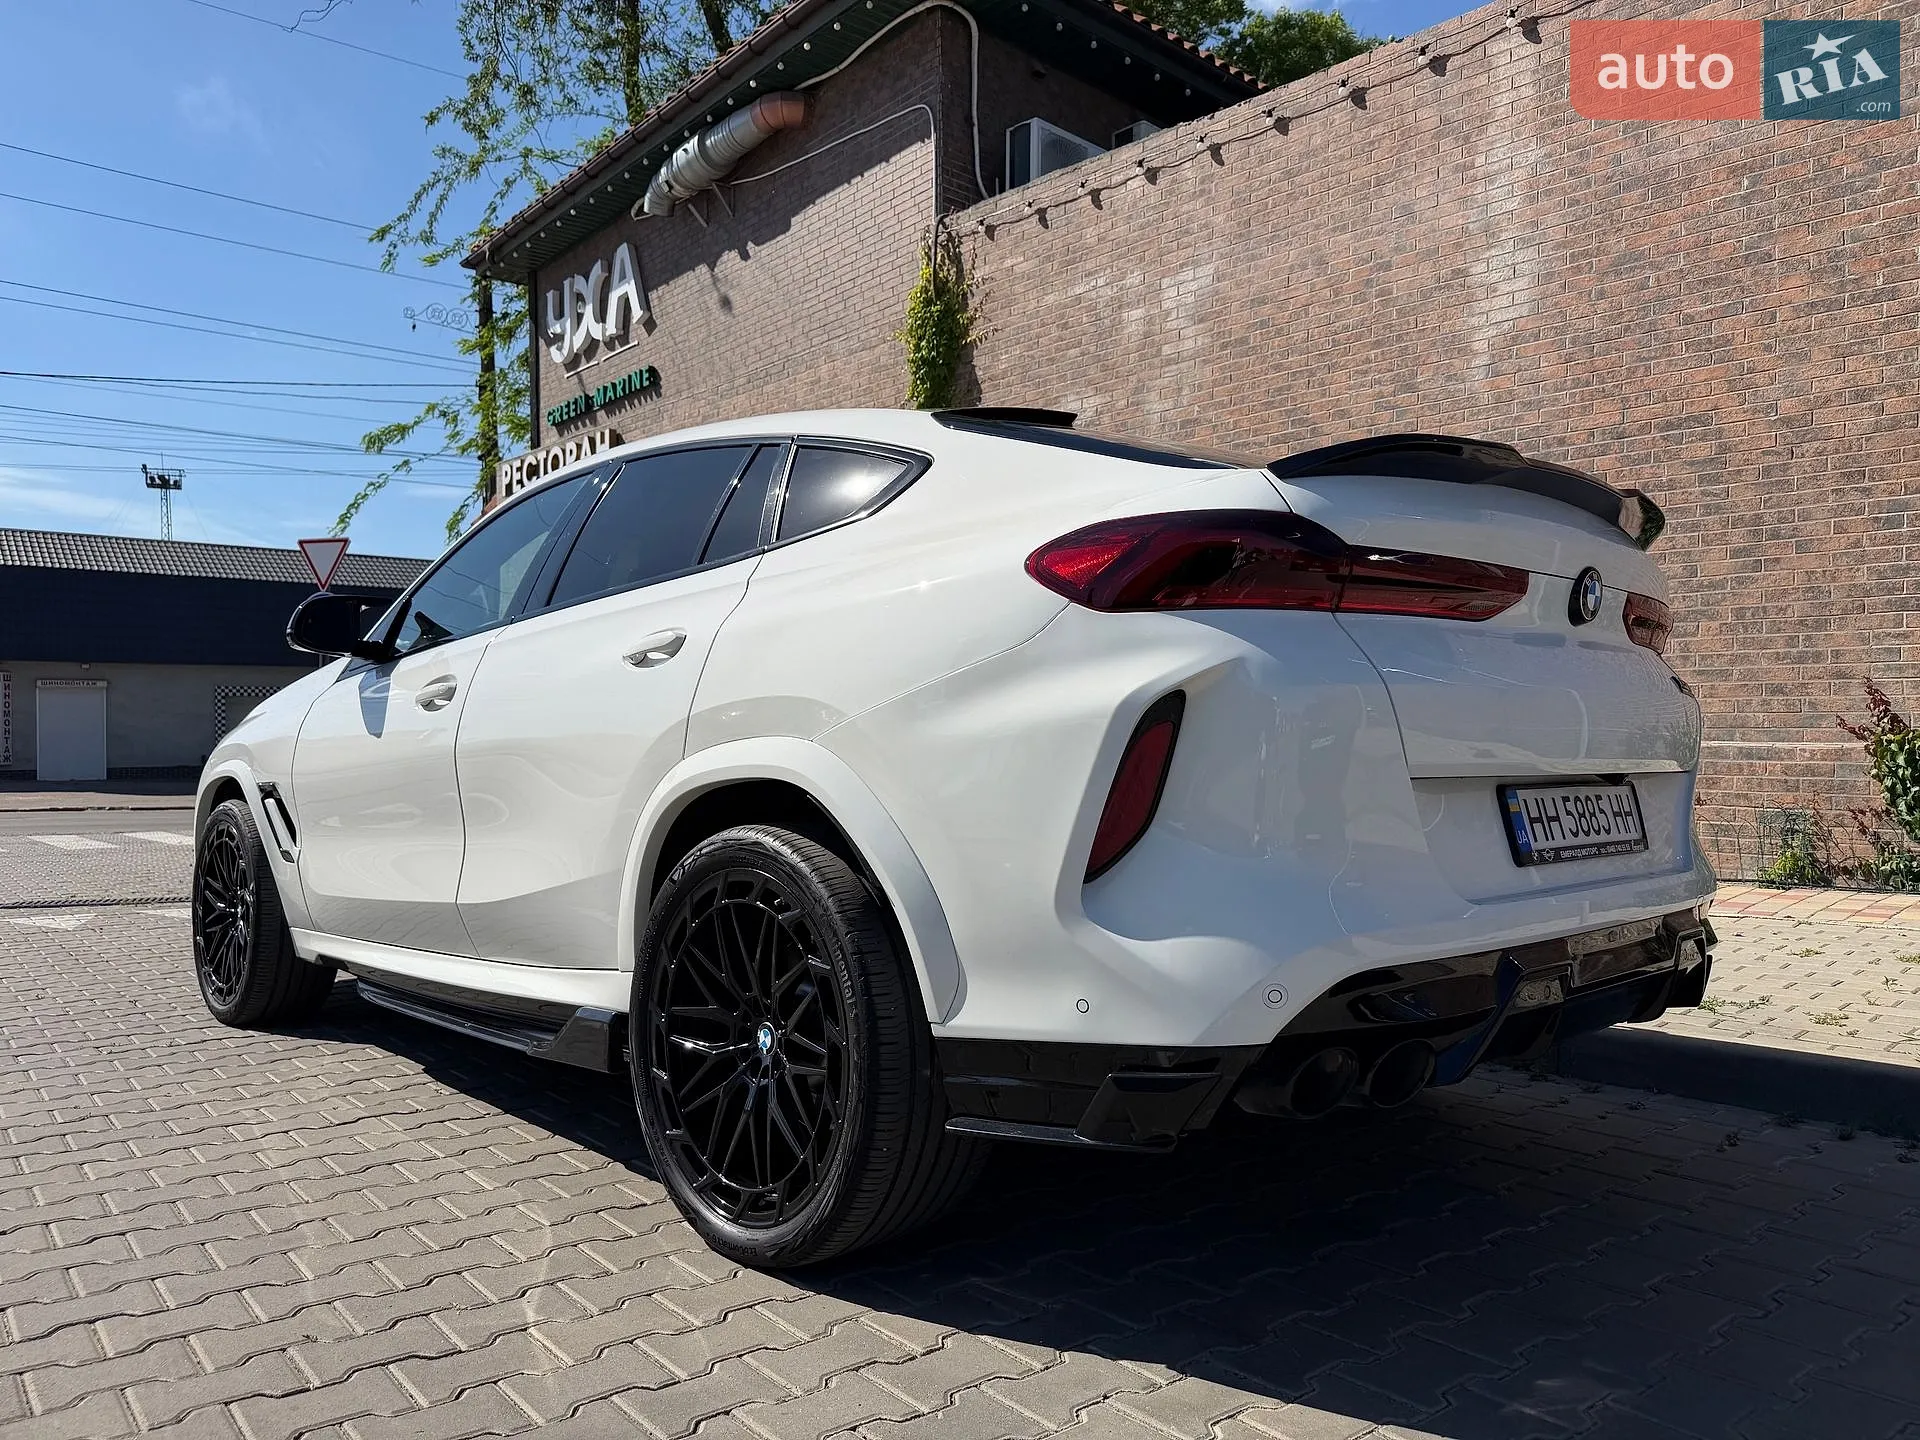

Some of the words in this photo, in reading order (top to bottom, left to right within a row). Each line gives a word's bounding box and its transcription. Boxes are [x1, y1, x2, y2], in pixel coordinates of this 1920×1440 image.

[547, 395, 585, 426] GREEN
[592, 365, 650, 409] MARINE
[501, 428, 611, 497] РЕСТОРАН
[3, 673, 12, 763] ШИНОМОНТАЖ
[1515, 829, 1531, 844] UA
[1523, 797, 1567, 843] HH
[1560, 794, 1612, 839] 5885
[1607, 793, 1638, 835] HH
